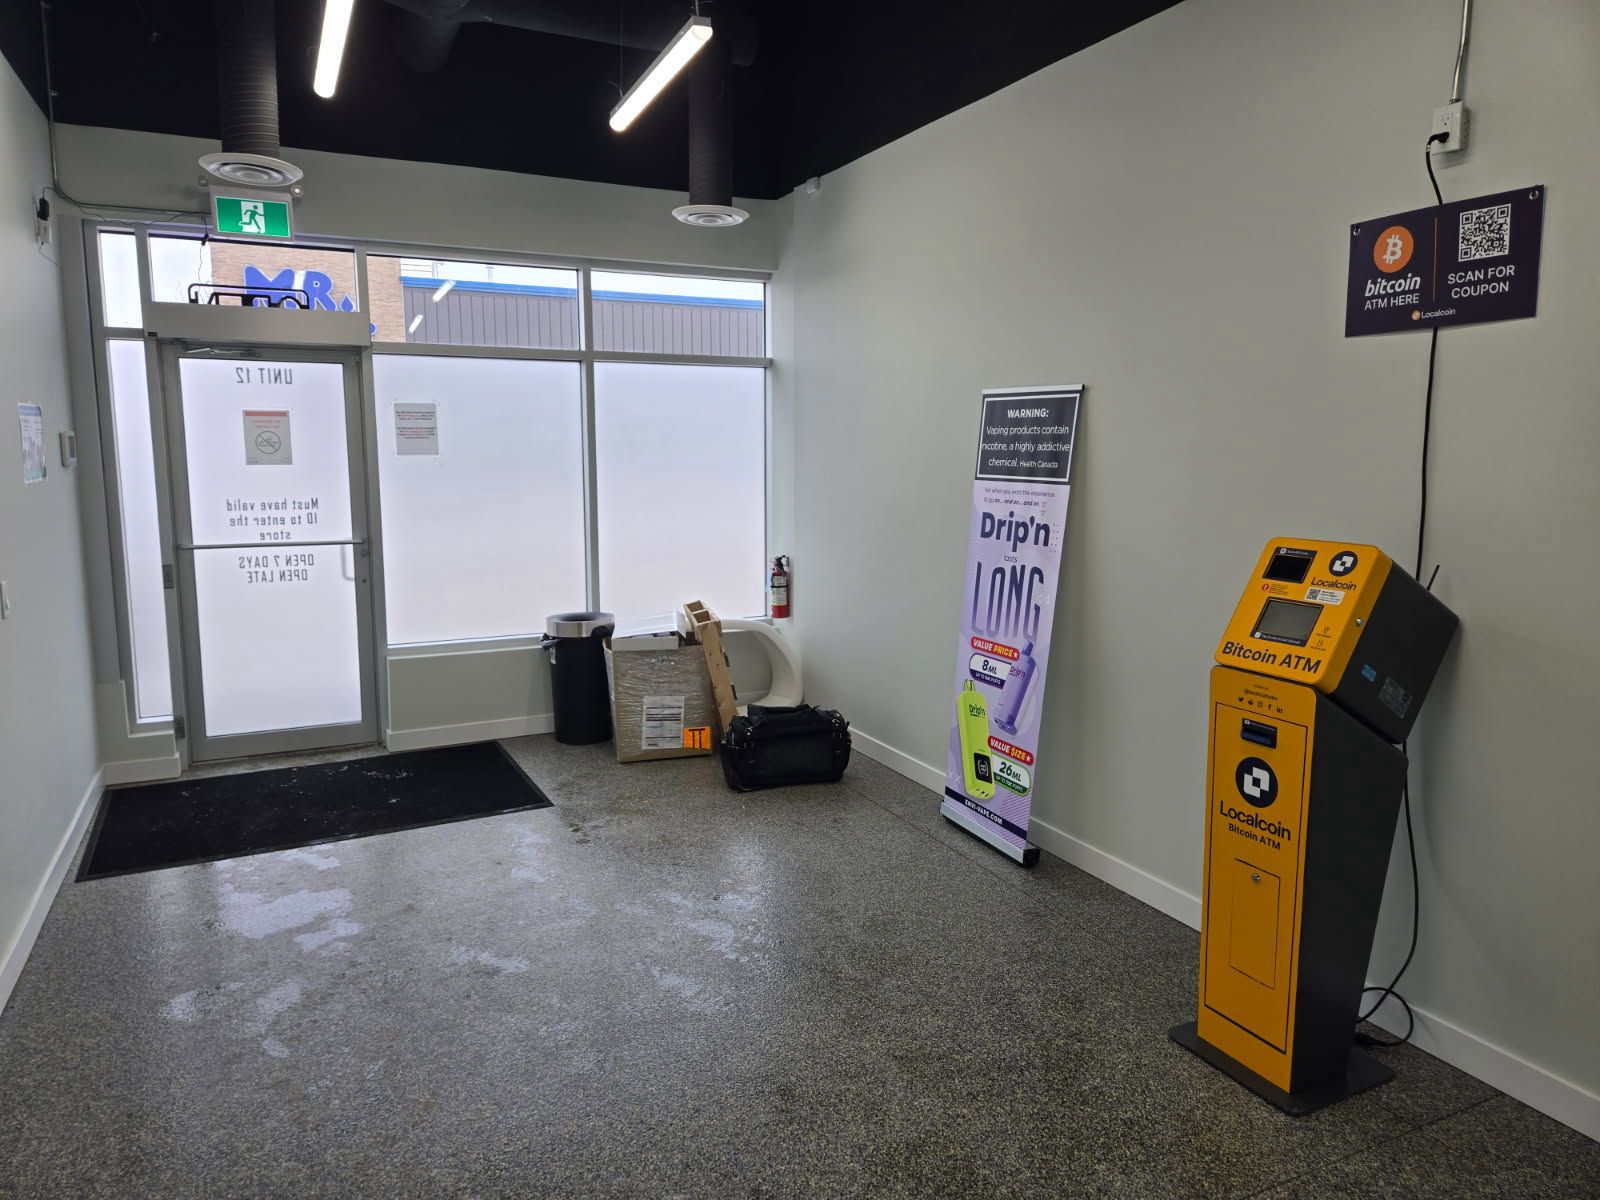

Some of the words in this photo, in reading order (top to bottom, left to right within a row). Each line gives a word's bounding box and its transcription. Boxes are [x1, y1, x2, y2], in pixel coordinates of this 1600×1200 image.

[1448, 269, 1484, 285] SCAN
[1488, 265, 1516, 278] FOR
[1365, 273, 1421, 297] bitcoin
[1451, 281, 1510, 299] COUPON
[1364, 298, 1388, 311] ATM
[1390, 293, 1420, 307] HERE
[1421, 308, 1456, 319] Localcoin
[1008, 408, 1049, 418] WARNING:
[987, 426, 1008, 436] Vaping
[1010, 425, 1040, 436] products
[1042, 425, 1069, 435] contain
[1015, 442, 1035, 453] highly
[1037, 442, 1070, 451] addictive
[988, 458, 1019, 467] chemical.
[980, 510, 1050, 552] Drip'n
[1004, 554, 1018, 563] lasts
[1311, 576, 1357, 592] Localcoin
[971, 560, 1044, 643] LONG
[973, 639, 993, 651] VALUE
[993, 644, 1013, 657] PRICE
[1222, 641, 1277, 666] Bitcoin
[1279, 654, 1322, 674] ATM
[990, 739, 1011, 753] VALUE
[965, 800, 1003, 825] ENVI-VAPE.COM
[1220, 800, 1291, 841] Localcoin
[1229, 823, 1258, 841] Bitcoin
[1260, 836, 1281, 851] ATM
